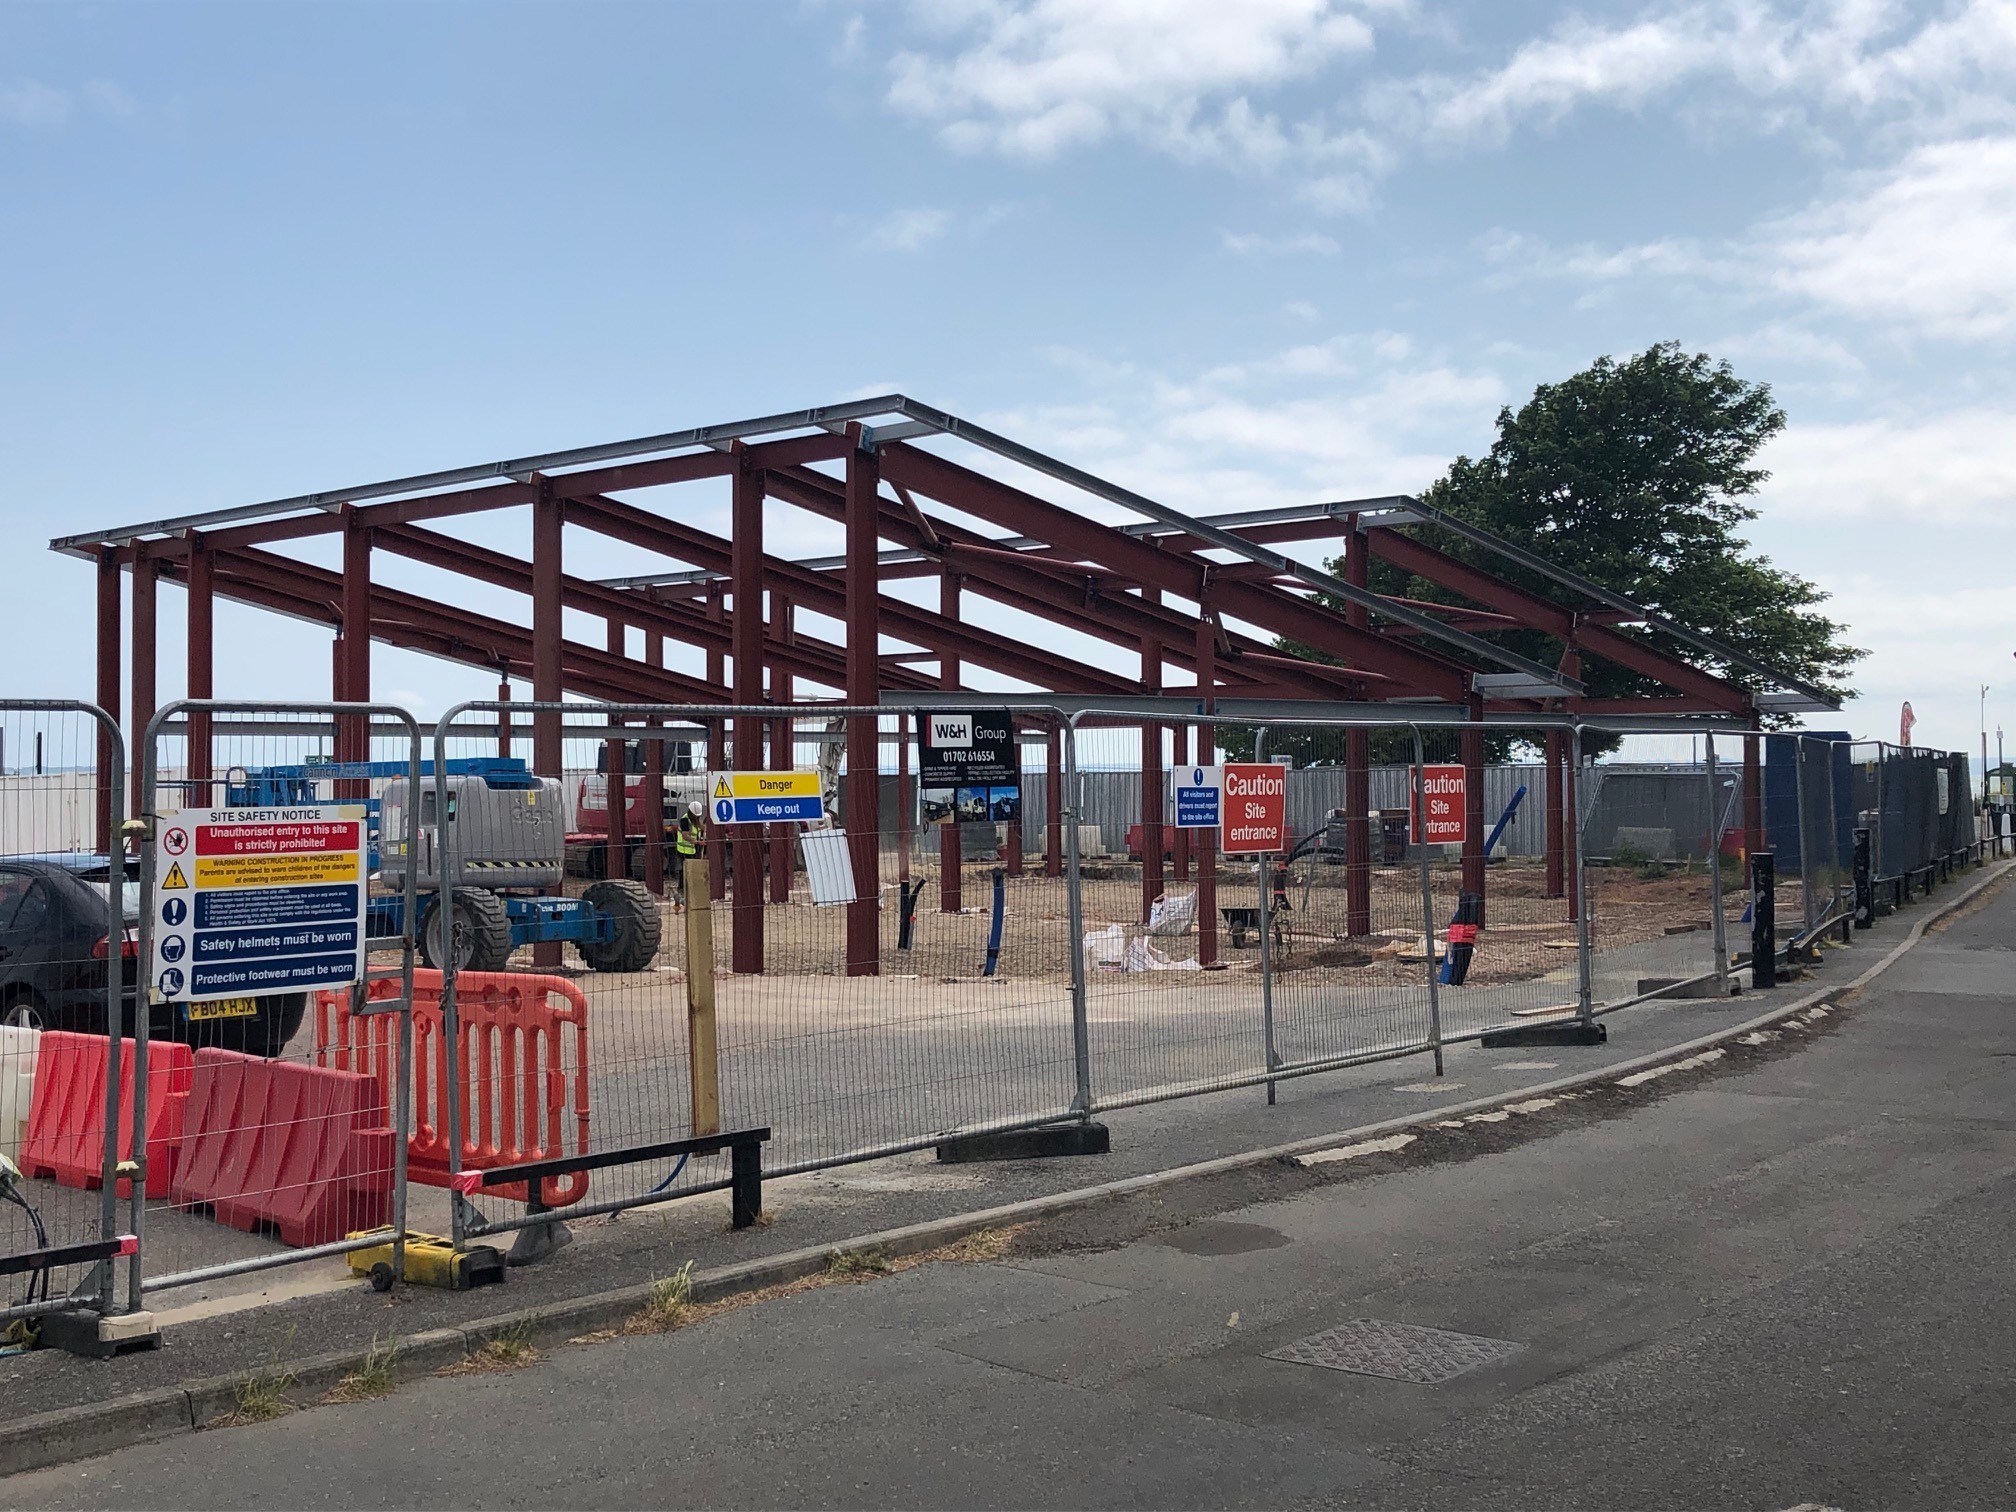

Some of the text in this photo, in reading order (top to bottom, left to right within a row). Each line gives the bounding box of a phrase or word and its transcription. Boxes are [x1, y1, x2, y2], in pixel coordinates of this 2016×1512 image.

[935, 724, 1007, 744] W&H Group
[943, 750, 995, 762] 01702 616554
[759, 779, 793, 792] Danger
[1225, 772, 1283, 796] Caution
[757, 803, 800, 817] Keep out
[1245, 802, 1266, 819] Site
[1430, 799, 1450, 815] Site
[210, 809, 321, 823] SITE SAFETY NOTICE
[210, 824, 348, 838] Unauthorised entry to this site
[1230, 825, 1278, 841] entrance
[1424, 819, 1461, 834] ntrance
[234, 837, 326, 850] is strictly prohibited
[213, 859, 246, 867] WARNING
[247, 856, 300, 866] CONSTRUCTION
[309, 854, 344, 862] PROGRESS
[332, 863, 355, 871] dangers
[243, 876, 269, 884] entering
[270, 874, 308, 882] construction
[200, 932, 352, 952] Safety helmets must be worn
[196, 963, 353, 985] Protective footwear must be worn
[190, 997, 254, 1018] FB04 HJX
